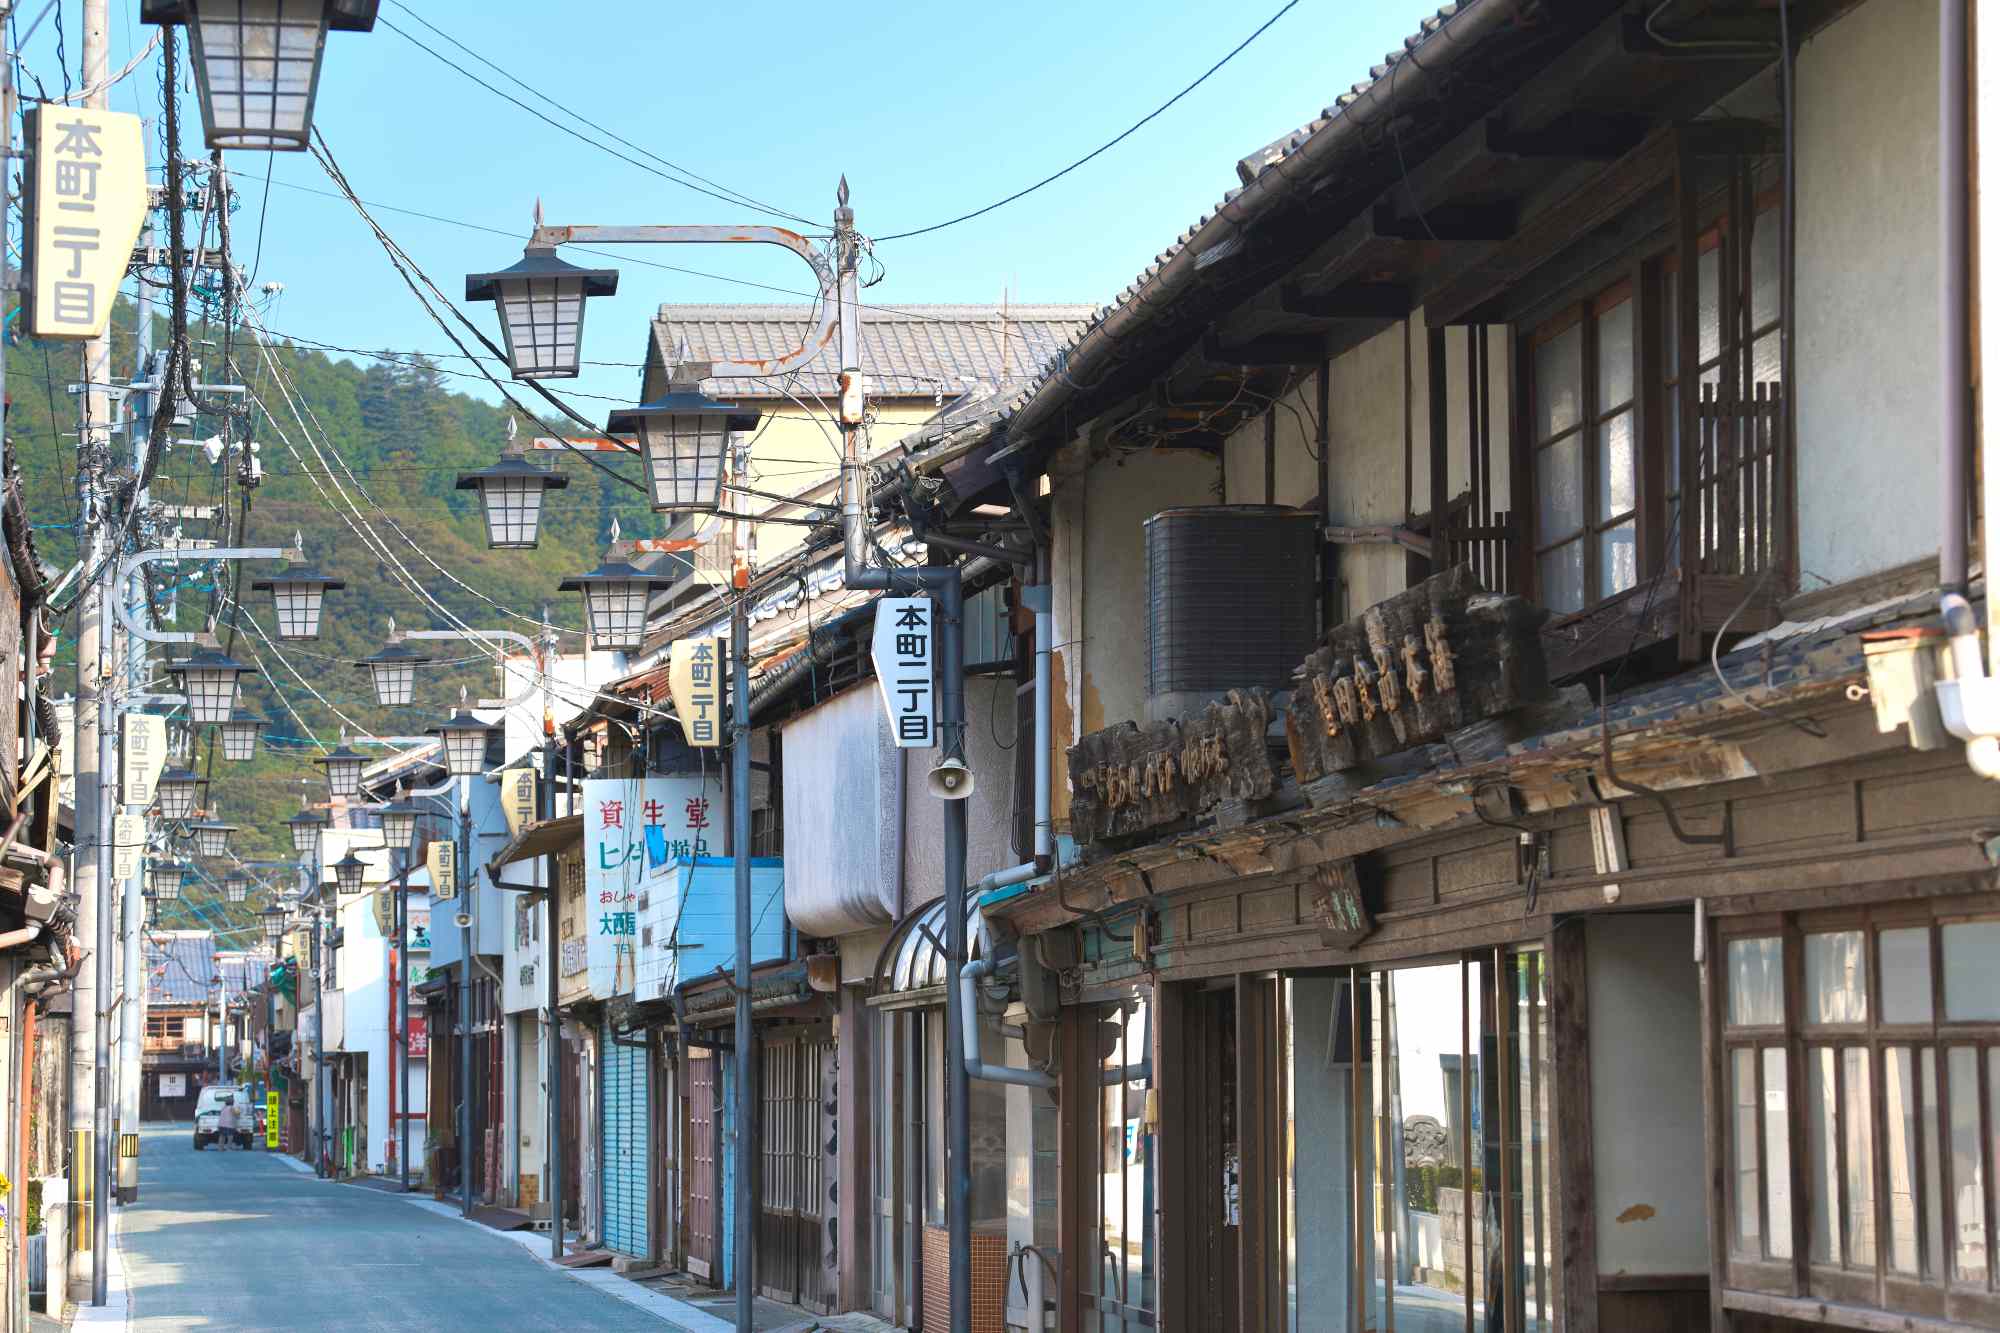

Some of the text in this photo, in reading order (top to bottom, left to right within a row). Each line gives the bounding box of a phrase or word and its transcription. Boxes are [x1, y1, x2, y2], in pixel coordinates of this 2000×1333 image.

[53, 118, 103, 325] 本町二丁目
[690, 642, 713, 742] 本町二丁目
[895, 605, 931, 740] 本町二丁目
[130, 718, 150, 801] 本町二丁目
[118, 819, 133, 876] 本町二丁目
[600, 797, 711, 830] 資生堂
